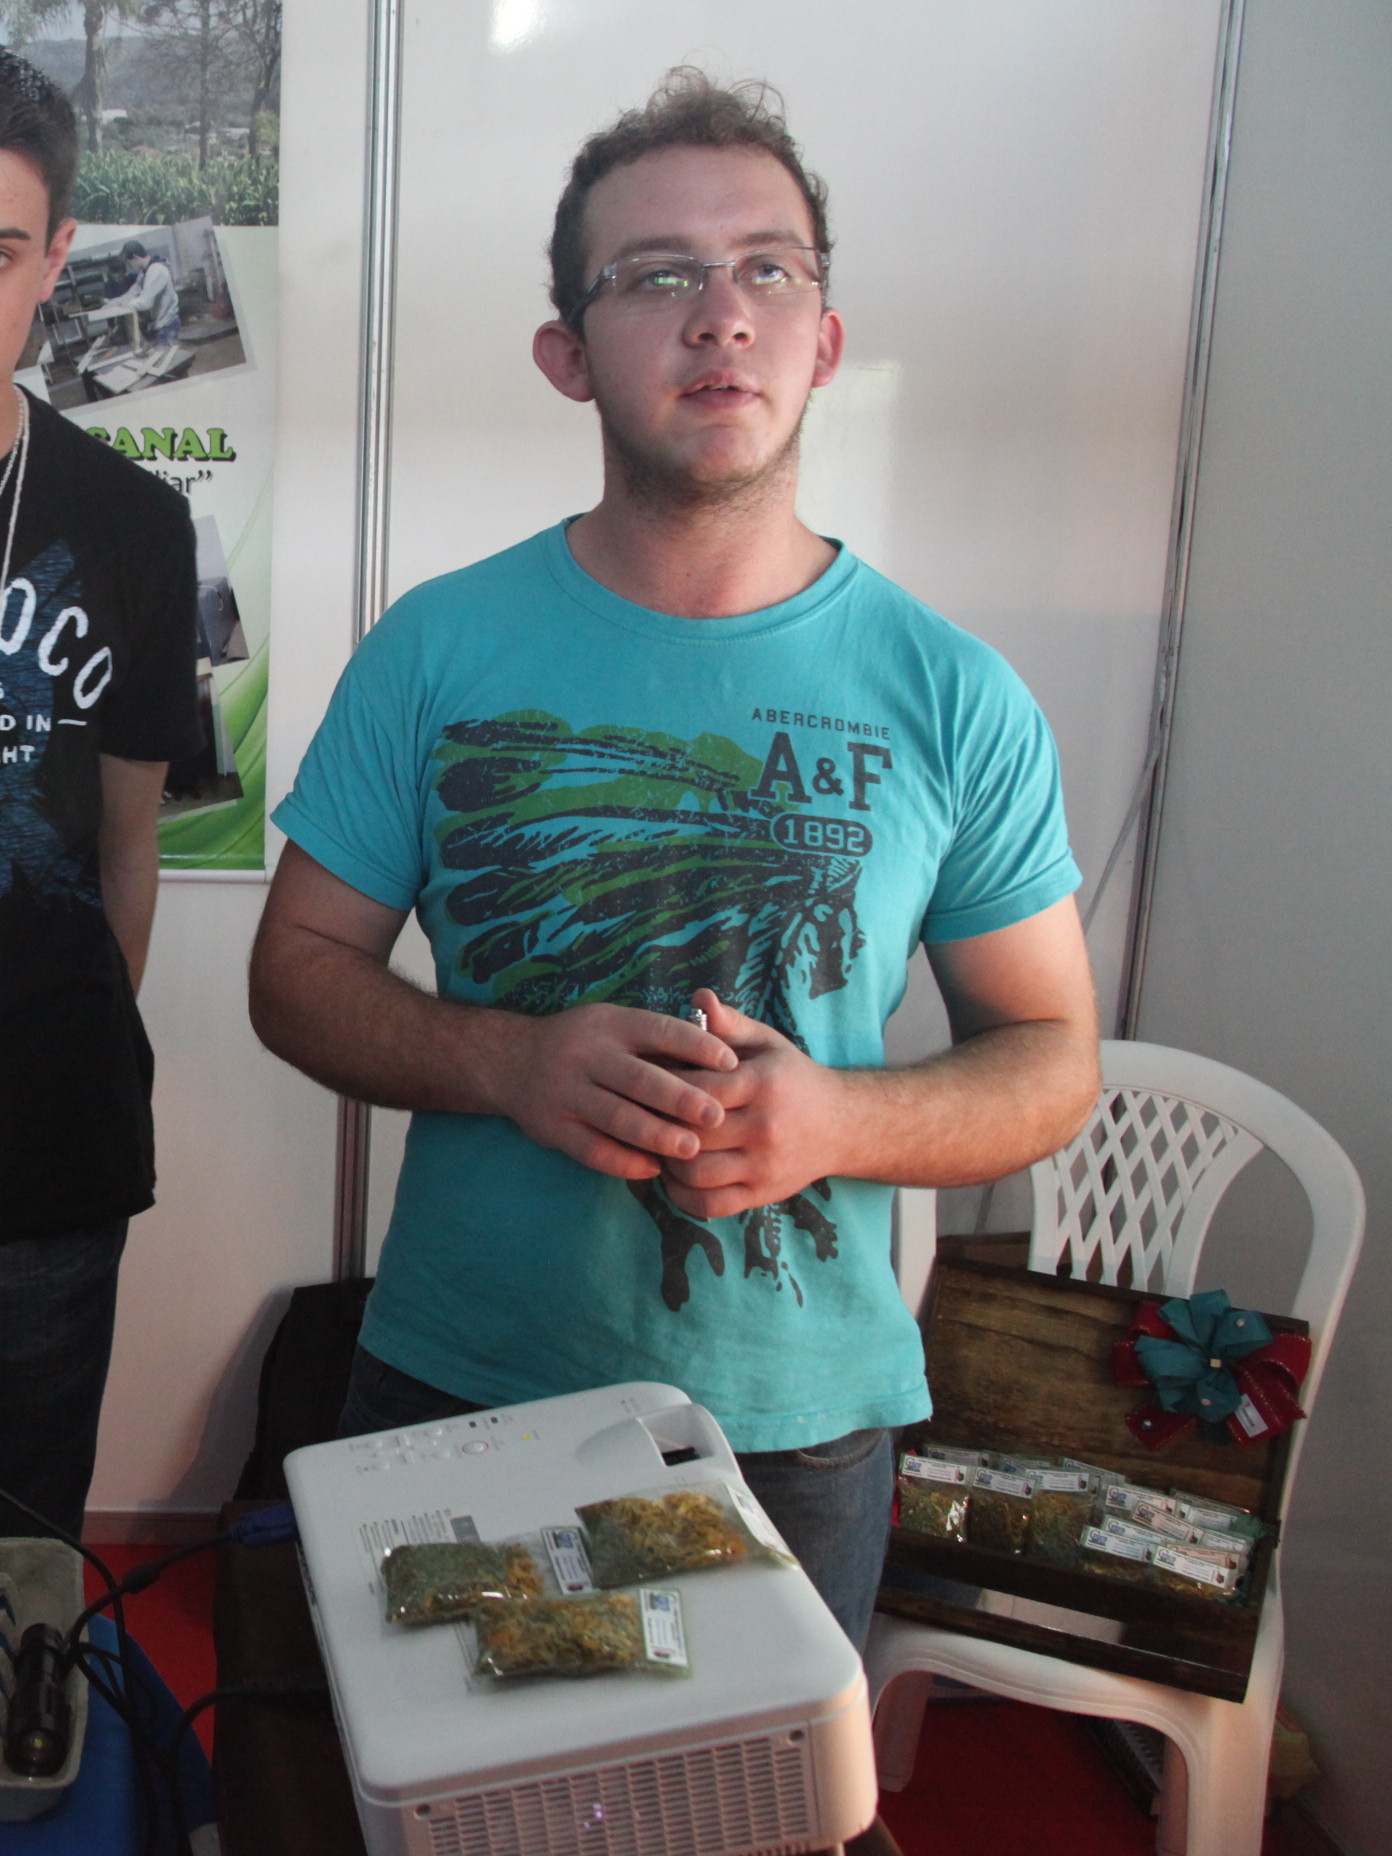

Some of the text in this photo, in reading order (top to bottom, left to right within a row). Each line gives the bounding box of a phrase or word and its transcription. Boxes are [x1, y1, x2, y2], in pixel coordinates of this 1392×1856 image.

[26, 714, 51, 732] IN
[752, 707, 891, 741] ABERCROMBIE
[749, 731, 893, 811] A&F
[783, 818, 865, 853] 1892
